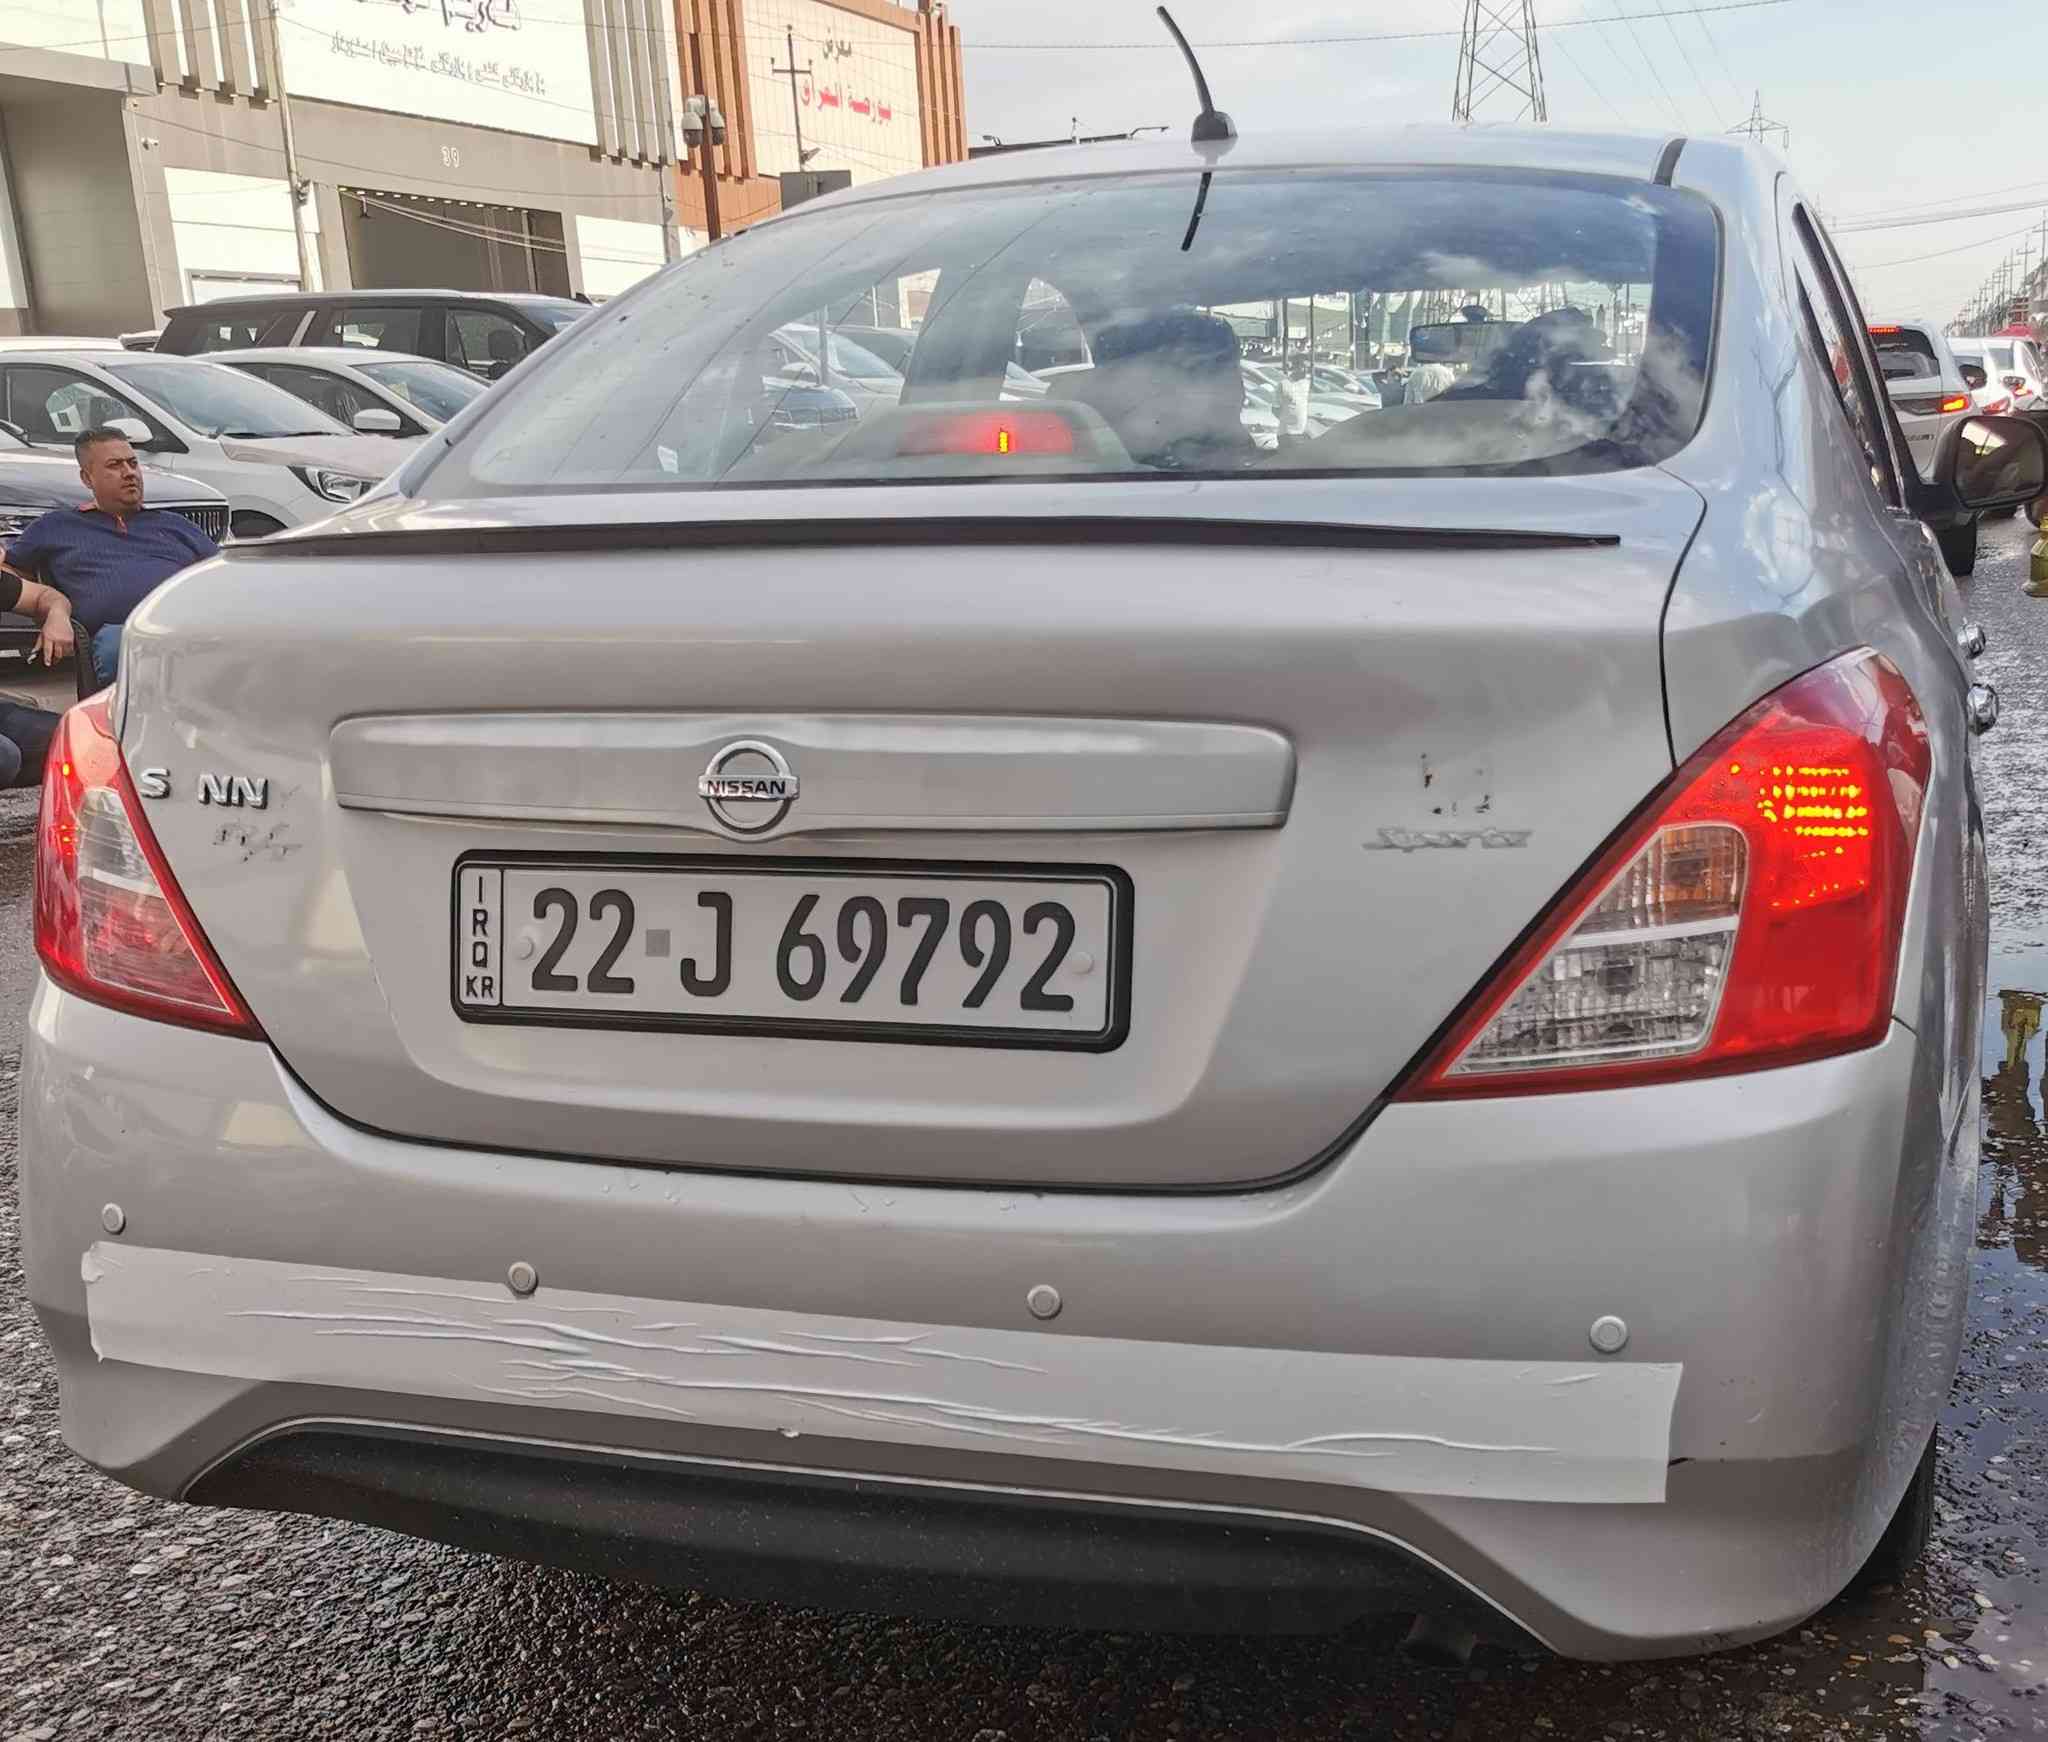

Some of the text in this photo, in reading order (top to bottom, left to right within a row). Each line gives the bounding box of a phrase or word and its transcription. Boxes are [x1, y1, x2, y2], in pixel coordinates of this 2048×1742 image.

[707, 780, 786, 795] NISSAN
[531, 888, 1075, 1012] 22 J 69792
[465, 974, 495, 999] KR
